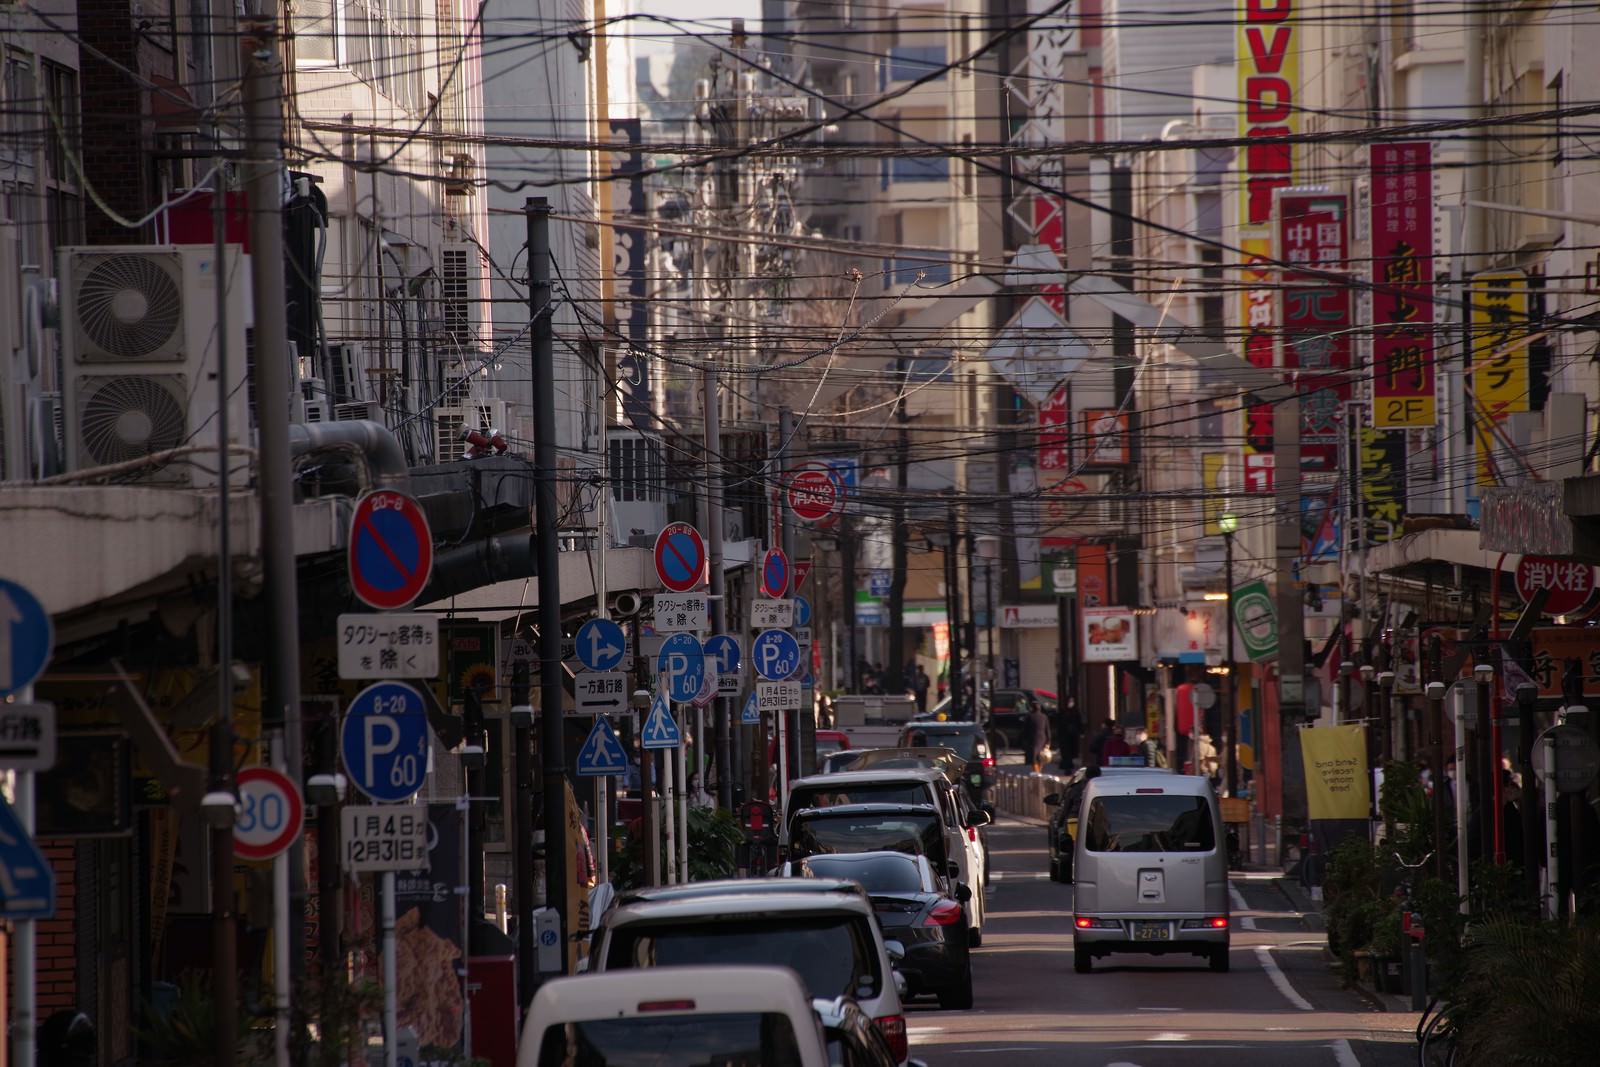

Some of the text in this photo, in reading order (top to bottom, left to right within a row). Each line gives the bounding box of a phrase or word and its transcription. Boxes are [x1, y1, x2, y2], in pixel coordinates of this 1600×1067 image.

[1287, 223, 1341, 247] 中国
[1385, 240, 1426, 391] 南大門
[1387, 400, 1424, 423] 2F
[370, 495, 404, 512] 20-8
[1523, 562, 1588, 592] 消火栓
[657, 600, 705, 612] タクシーの客待ち
[667, 613, 697, 626] を除く
[344, 624, 433, 645] タクシーの客待ち
[361, 649, 416, 670] を除く
[762, 643, 780, 676] P
[774, 660, 790, 675] 60
[668, 652, 689, 695] P
[579, 679, 623, 694] 一方通行路
[682, 675, 697, 694] 60
[760, 685, 799, 696] 1月4日から
[373, 695, 407, 713] 8-20
[759, 696, 800, 707] 12月31日まで
[363, 715, 401, 788] P
[389, 754, 417, 787] 60
